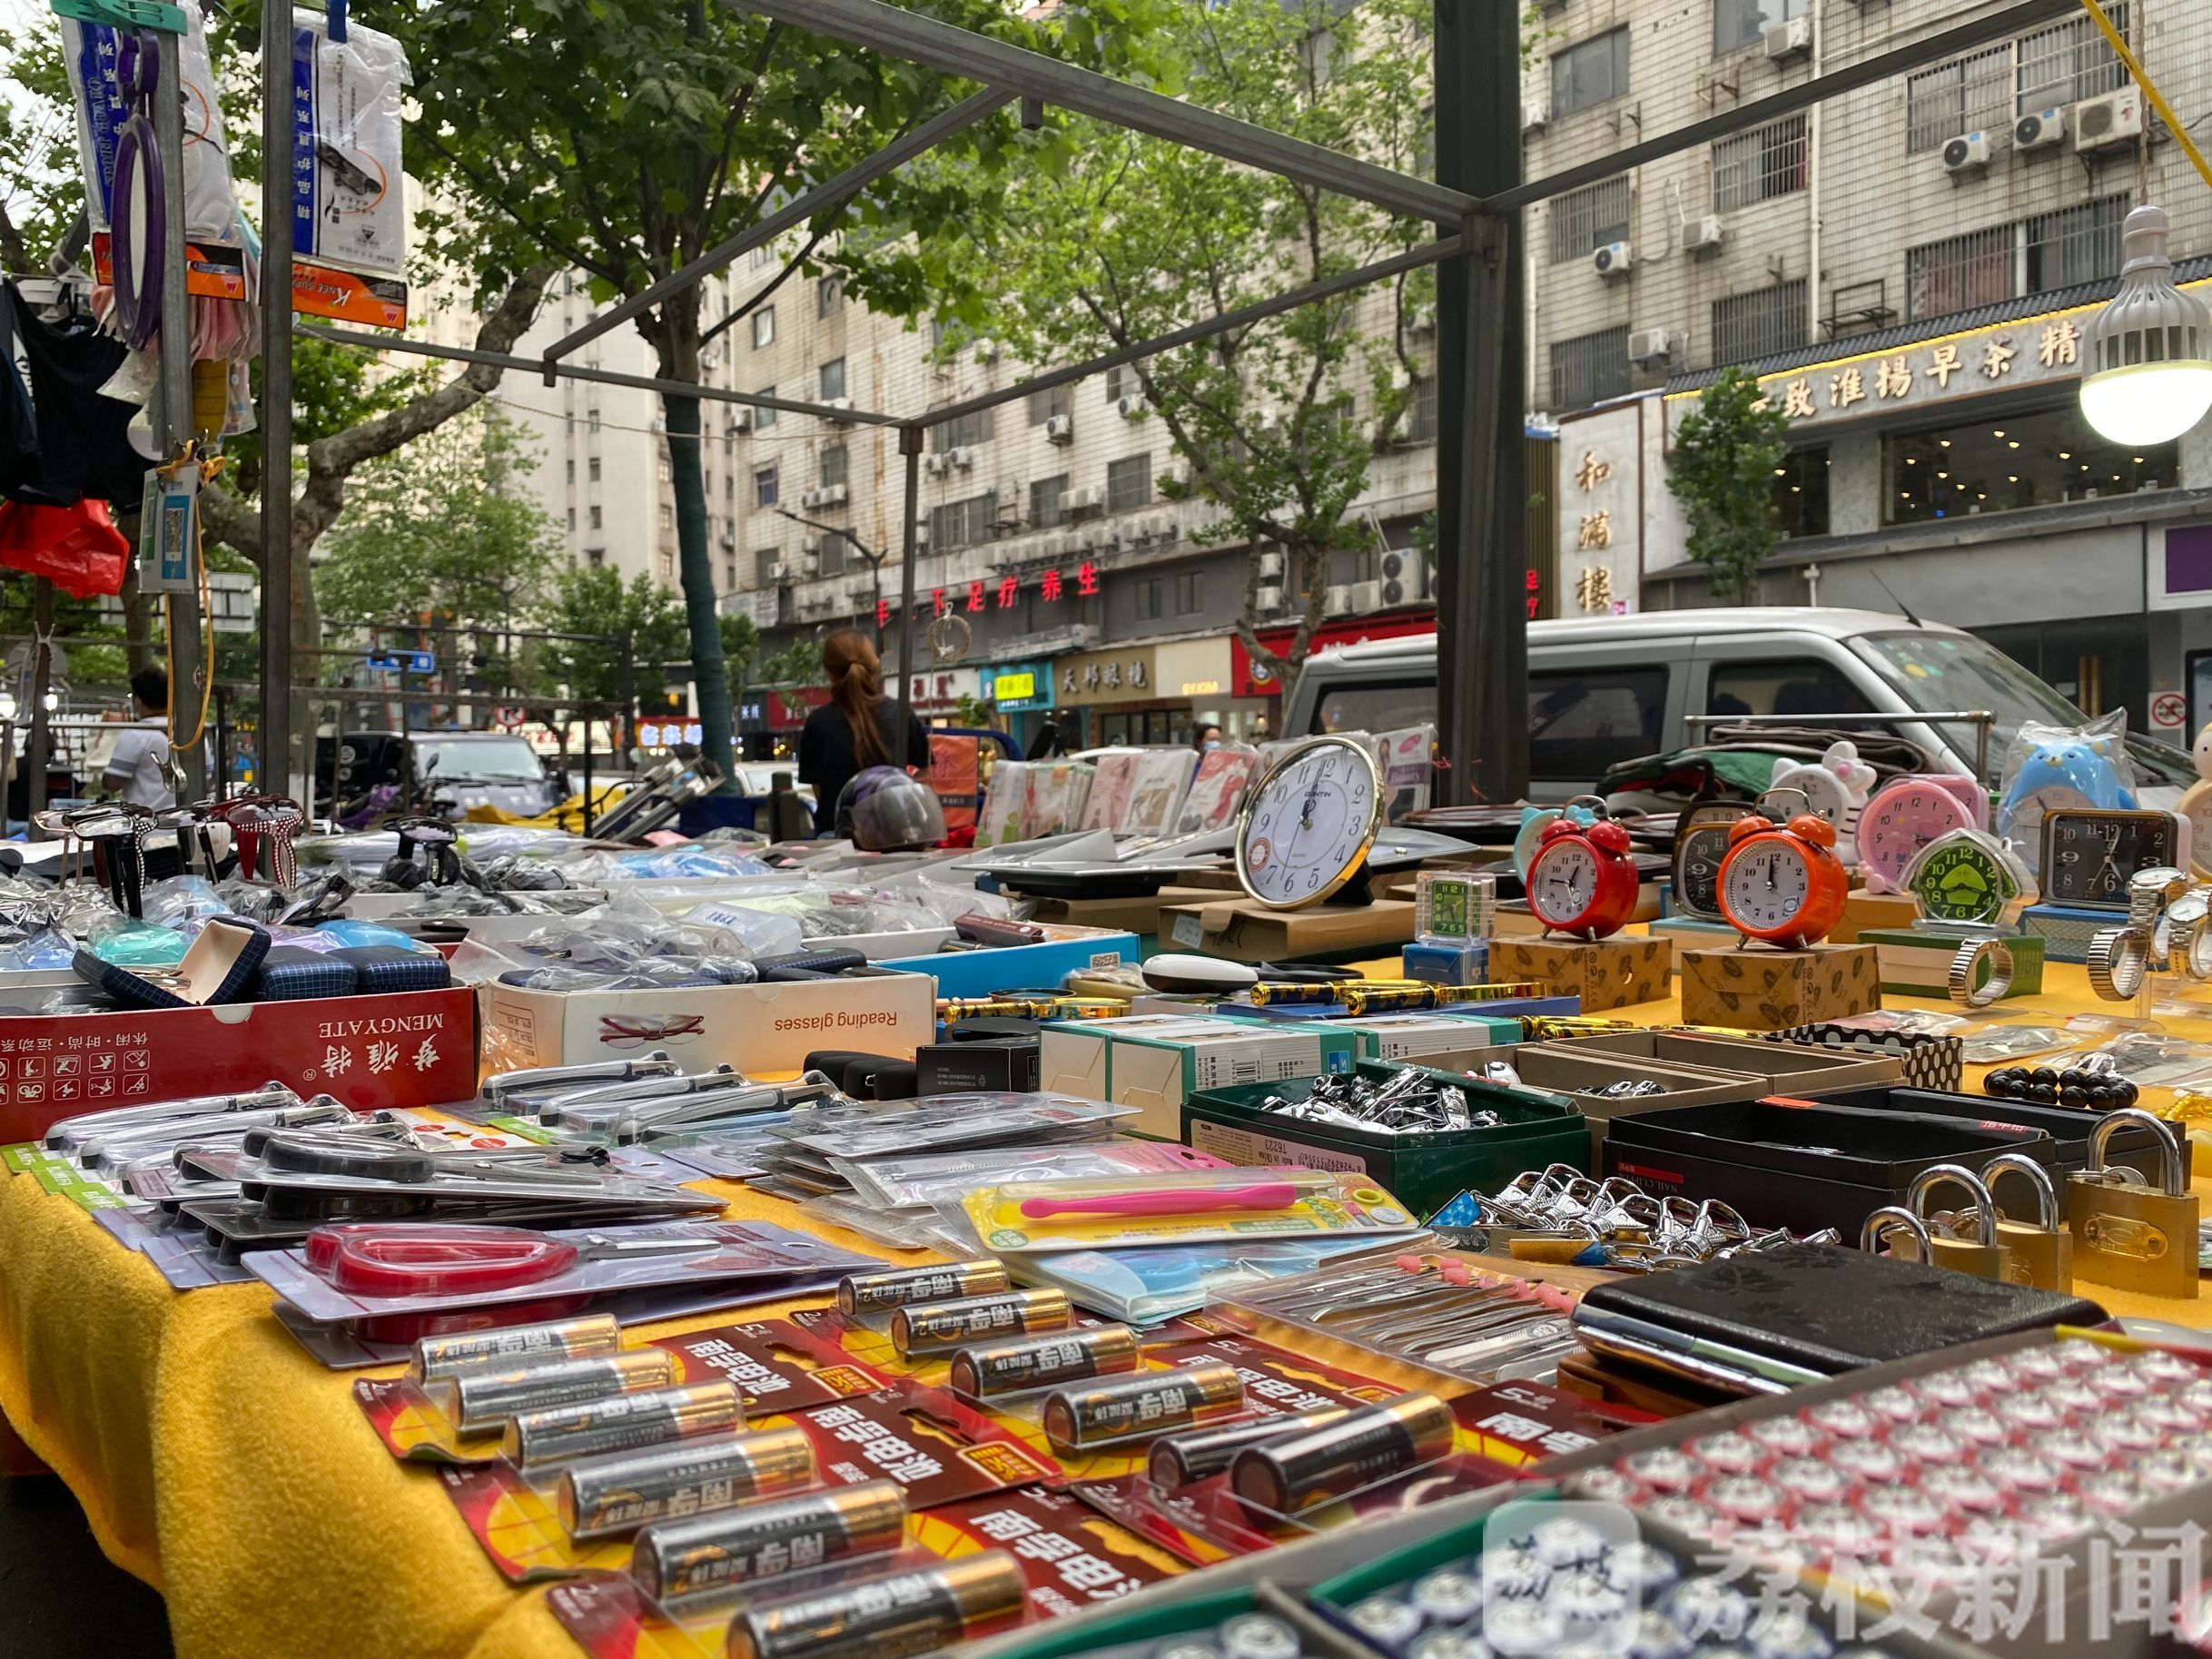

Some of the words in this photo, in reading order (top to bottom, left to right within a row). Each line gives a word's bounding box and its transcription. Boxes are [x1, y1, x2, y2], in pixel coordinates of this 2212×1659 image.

[295, 84, 312, 221] 精品护具系列
[315, 281, 353, 308] KNEE
[875, 560, 1099, 628] 手下足疗养生
[1298, 765, 1310, 784] 11
[1346, 765, 1354, 784] 1
[1273, 784, 1288, 804] 10
[1351, 785, 1365, 805] 2
[1260, 814, 1270, 832] 9
[1348, 815, 1361, 835] 3
[1334, 844, 1346, 864] 4
[1946, 854, 1956, 864] 11
[1959, 847, 1974, 859] 12
[1979, 856, 1984, 867] 1
[1266, 864, 1278, 884] 7
[1308, 868, 1320, 889] 5
[1931, 864, 1945, 875] 10
[1986, 866, 1997, 878] 2
[1284, 872, 1295, 893] 6
[1926, 877, 1936, 889] 9
[1931, 891, 1941, 902] 8
[1982, 896, 1992, 906] 4
[1941, 905, 1951, 917] 7
[1956, 906, 1966, 918] 6
[1972, 908, 1982, 917] 5
[319, 1012, 444, 1038] MENGYATE
[775, 1013, 833, 1032] glasses
[836, 1011, 897, 1027] Reading
[323, 1034, 443, 1079] 梦雅特
[1264, 1139, 1288, 1154] T6223
[911, 1274, 953, 1299] 南孚
[968, 1304, 1014, 1331] 南孚
[496, 1328, 551, 1355] 南孚
[1035, 1342, 1083, 1371] 南孚
[684, 1338, 792, 1396] 南孚电池
[1136, 1387, 1187, 1420] 南孚
[806, 1404, 943, 1484] 南孚电池
[667, 1478, 733, 1516] 南孚
[755, 1532, 825, 1576] 南孚
